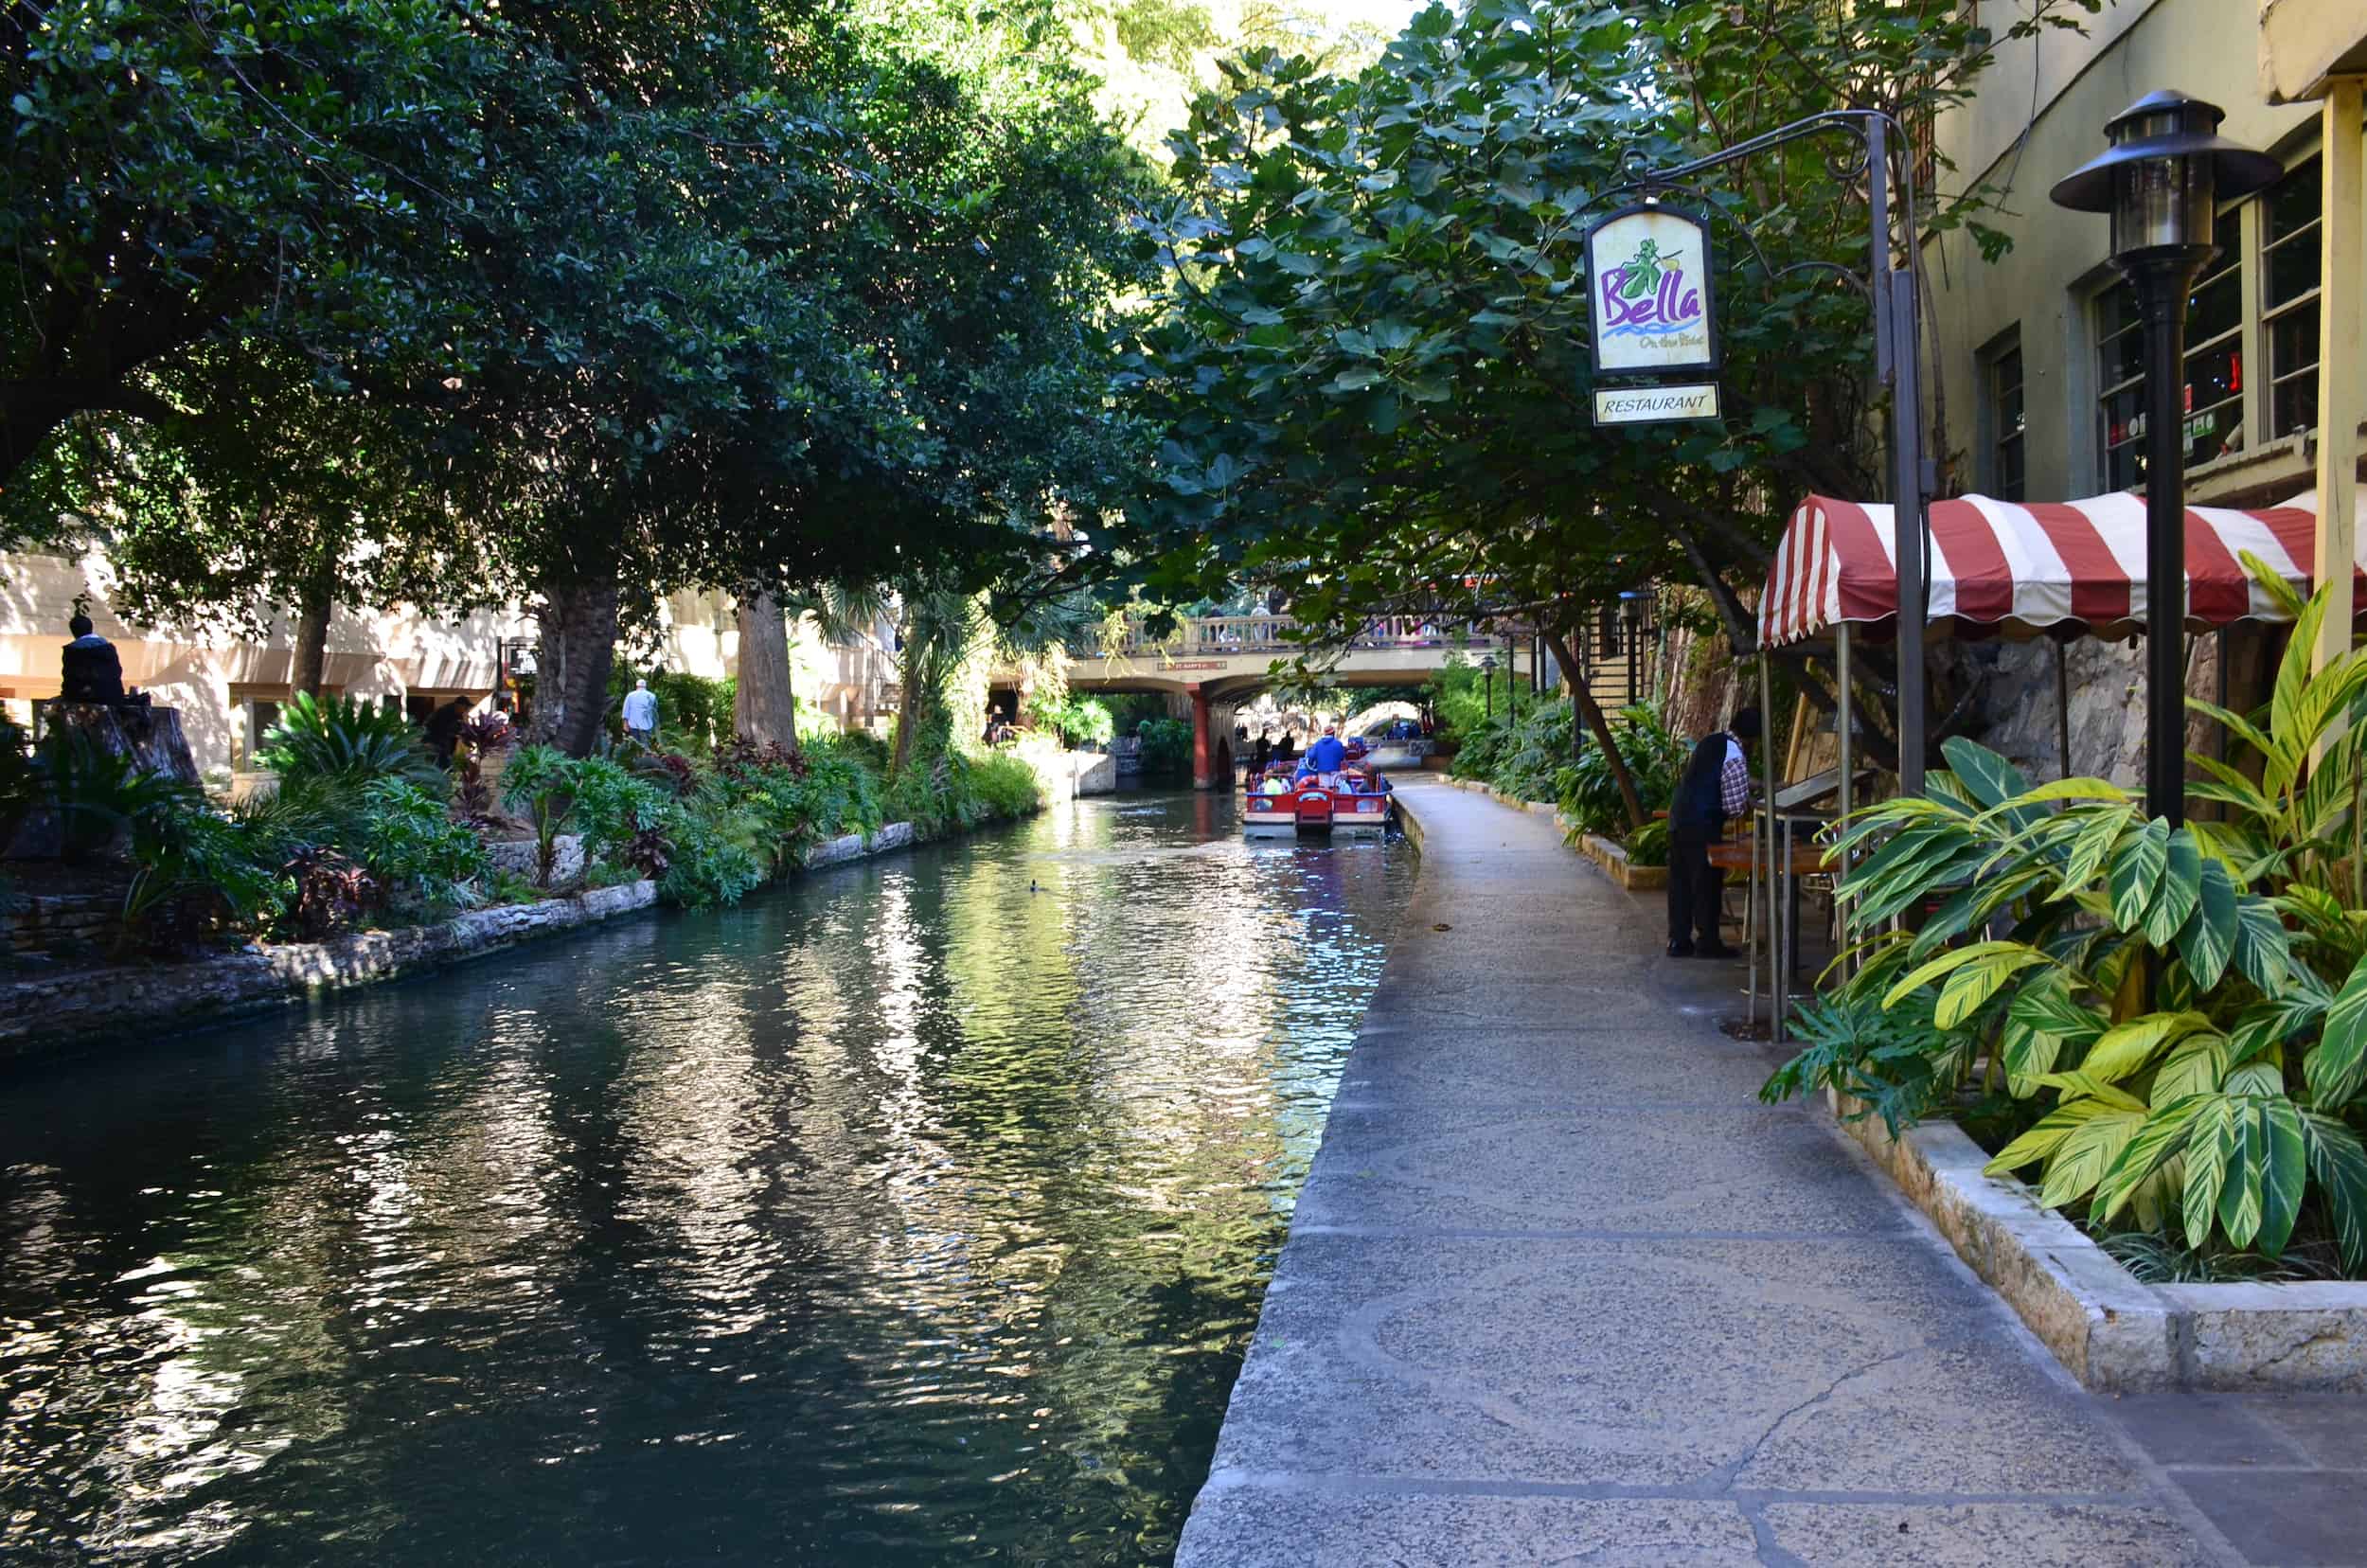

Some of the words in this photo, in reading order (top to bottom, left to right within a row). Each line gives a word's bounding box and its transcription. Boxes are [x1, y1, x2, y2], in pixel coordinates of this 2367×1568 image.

[1601, 268, 1700, 326] Bella
[1640, 336, 1658, 348] On
[1604, 395, 1708, 415] RESTAURANT
